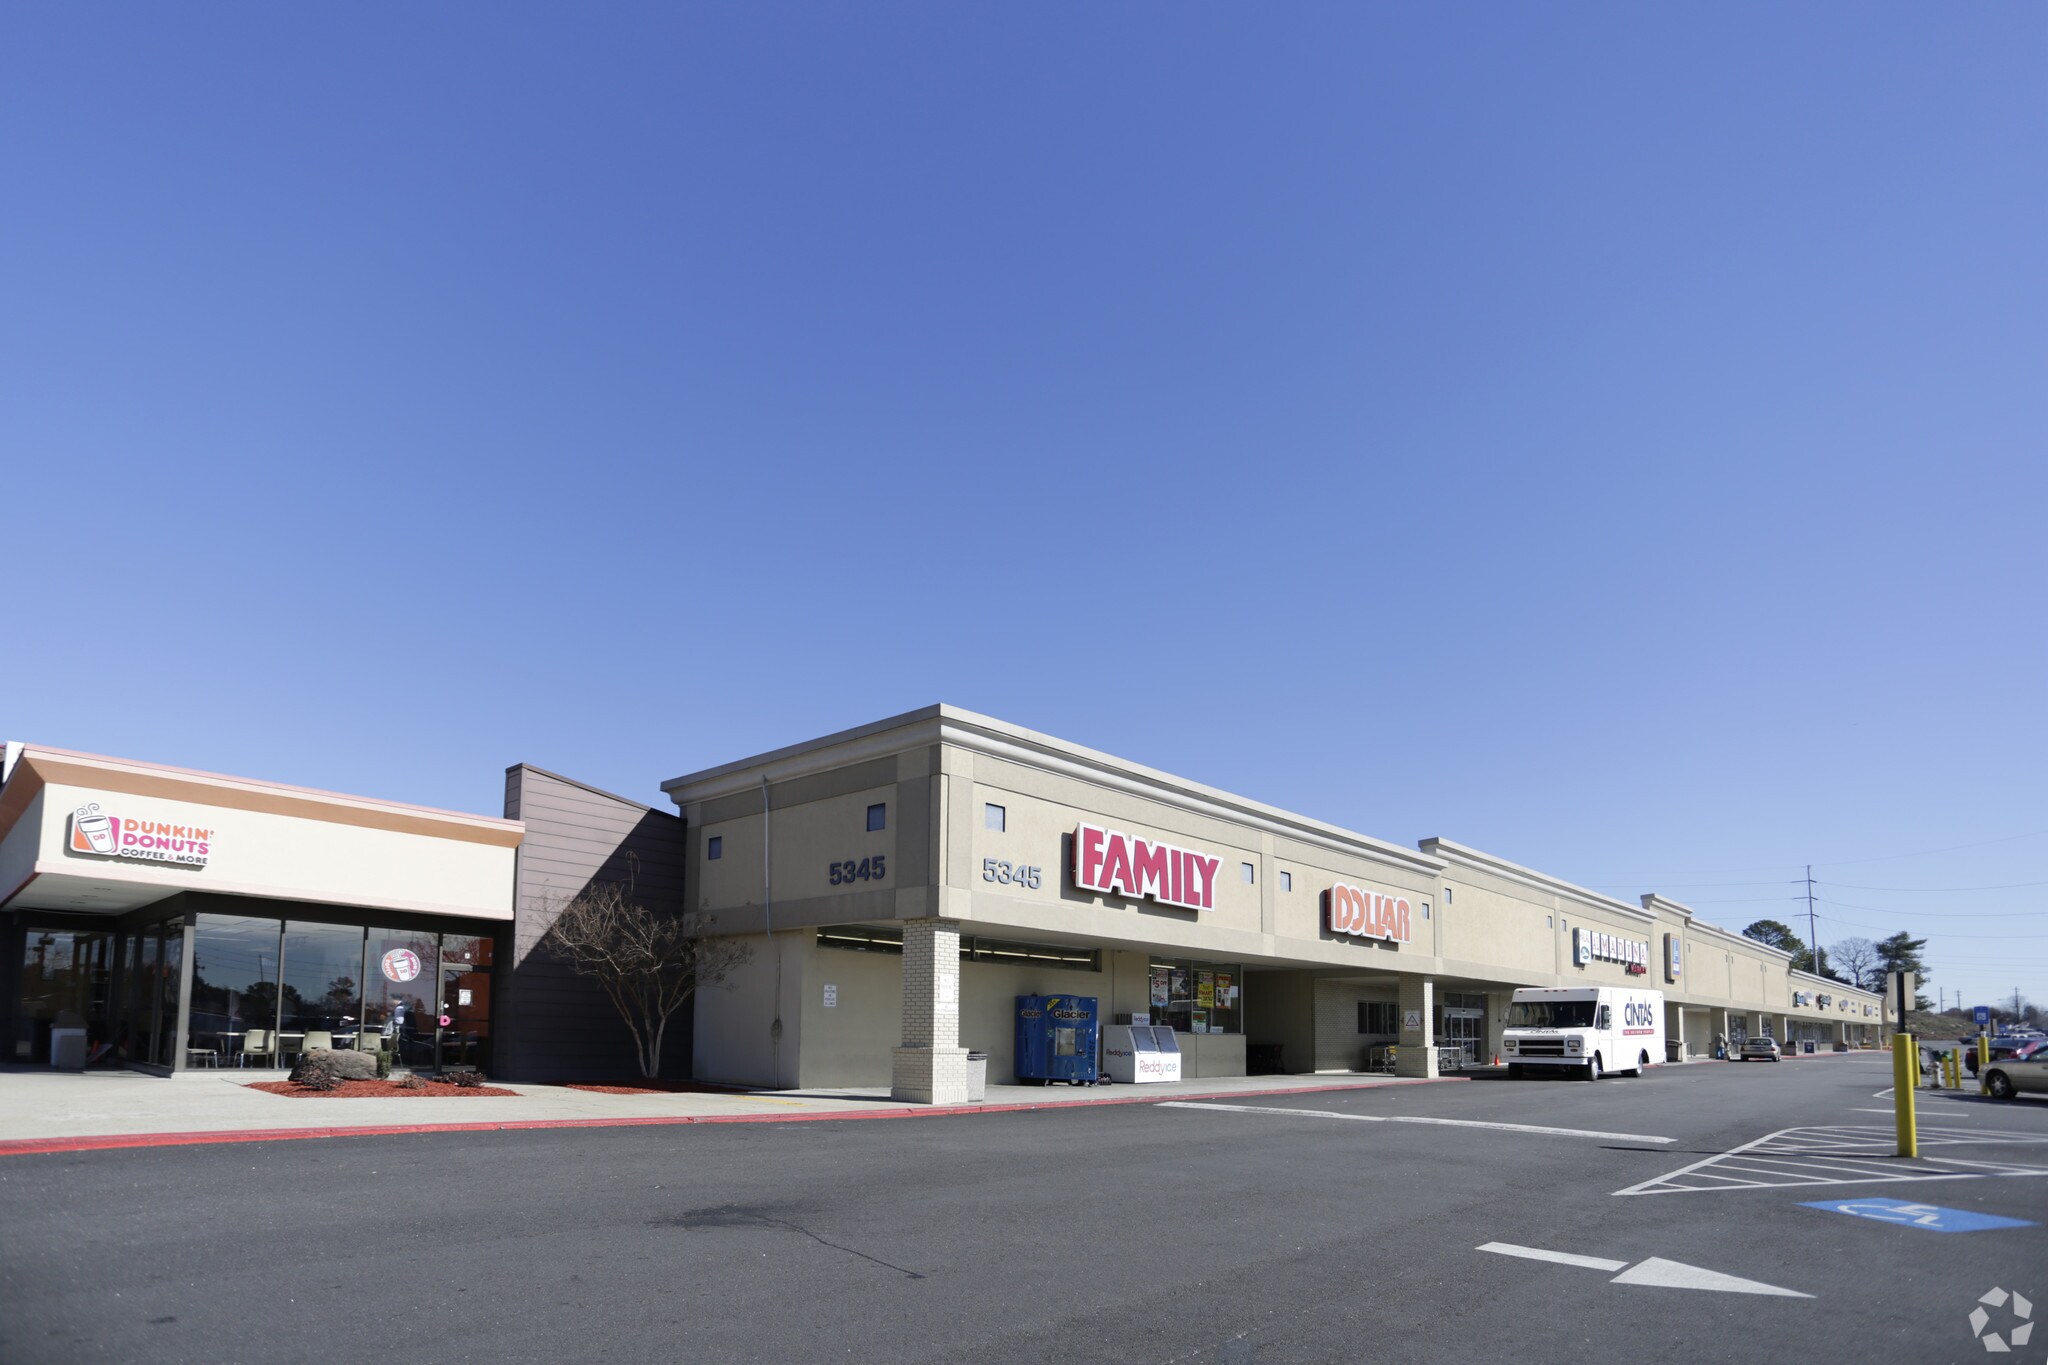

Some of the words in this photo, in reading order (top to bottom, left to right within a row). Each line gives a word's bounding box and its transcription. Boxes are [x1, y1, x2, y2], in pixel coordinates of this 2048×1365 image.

[124, 819, 214, 841] DUNKIN'
[121, 848, 165, 860] COFFEE
[176, 854, 208, 865] MORE
[123, 833, 209, 855] DONUTS
[829, 855, 885, 886] 5345
[983, 858, 1041, 889] 5345
[1082, 827, 1219, 909] FAMILY
[1335, 885, 1410, 942] DOLLAR
[1601, 937, 1647, 961] MADINA
[1053, 1009, 1090, 1019] Glacier
[1625, 996, 1653, 1026] CINTAS
